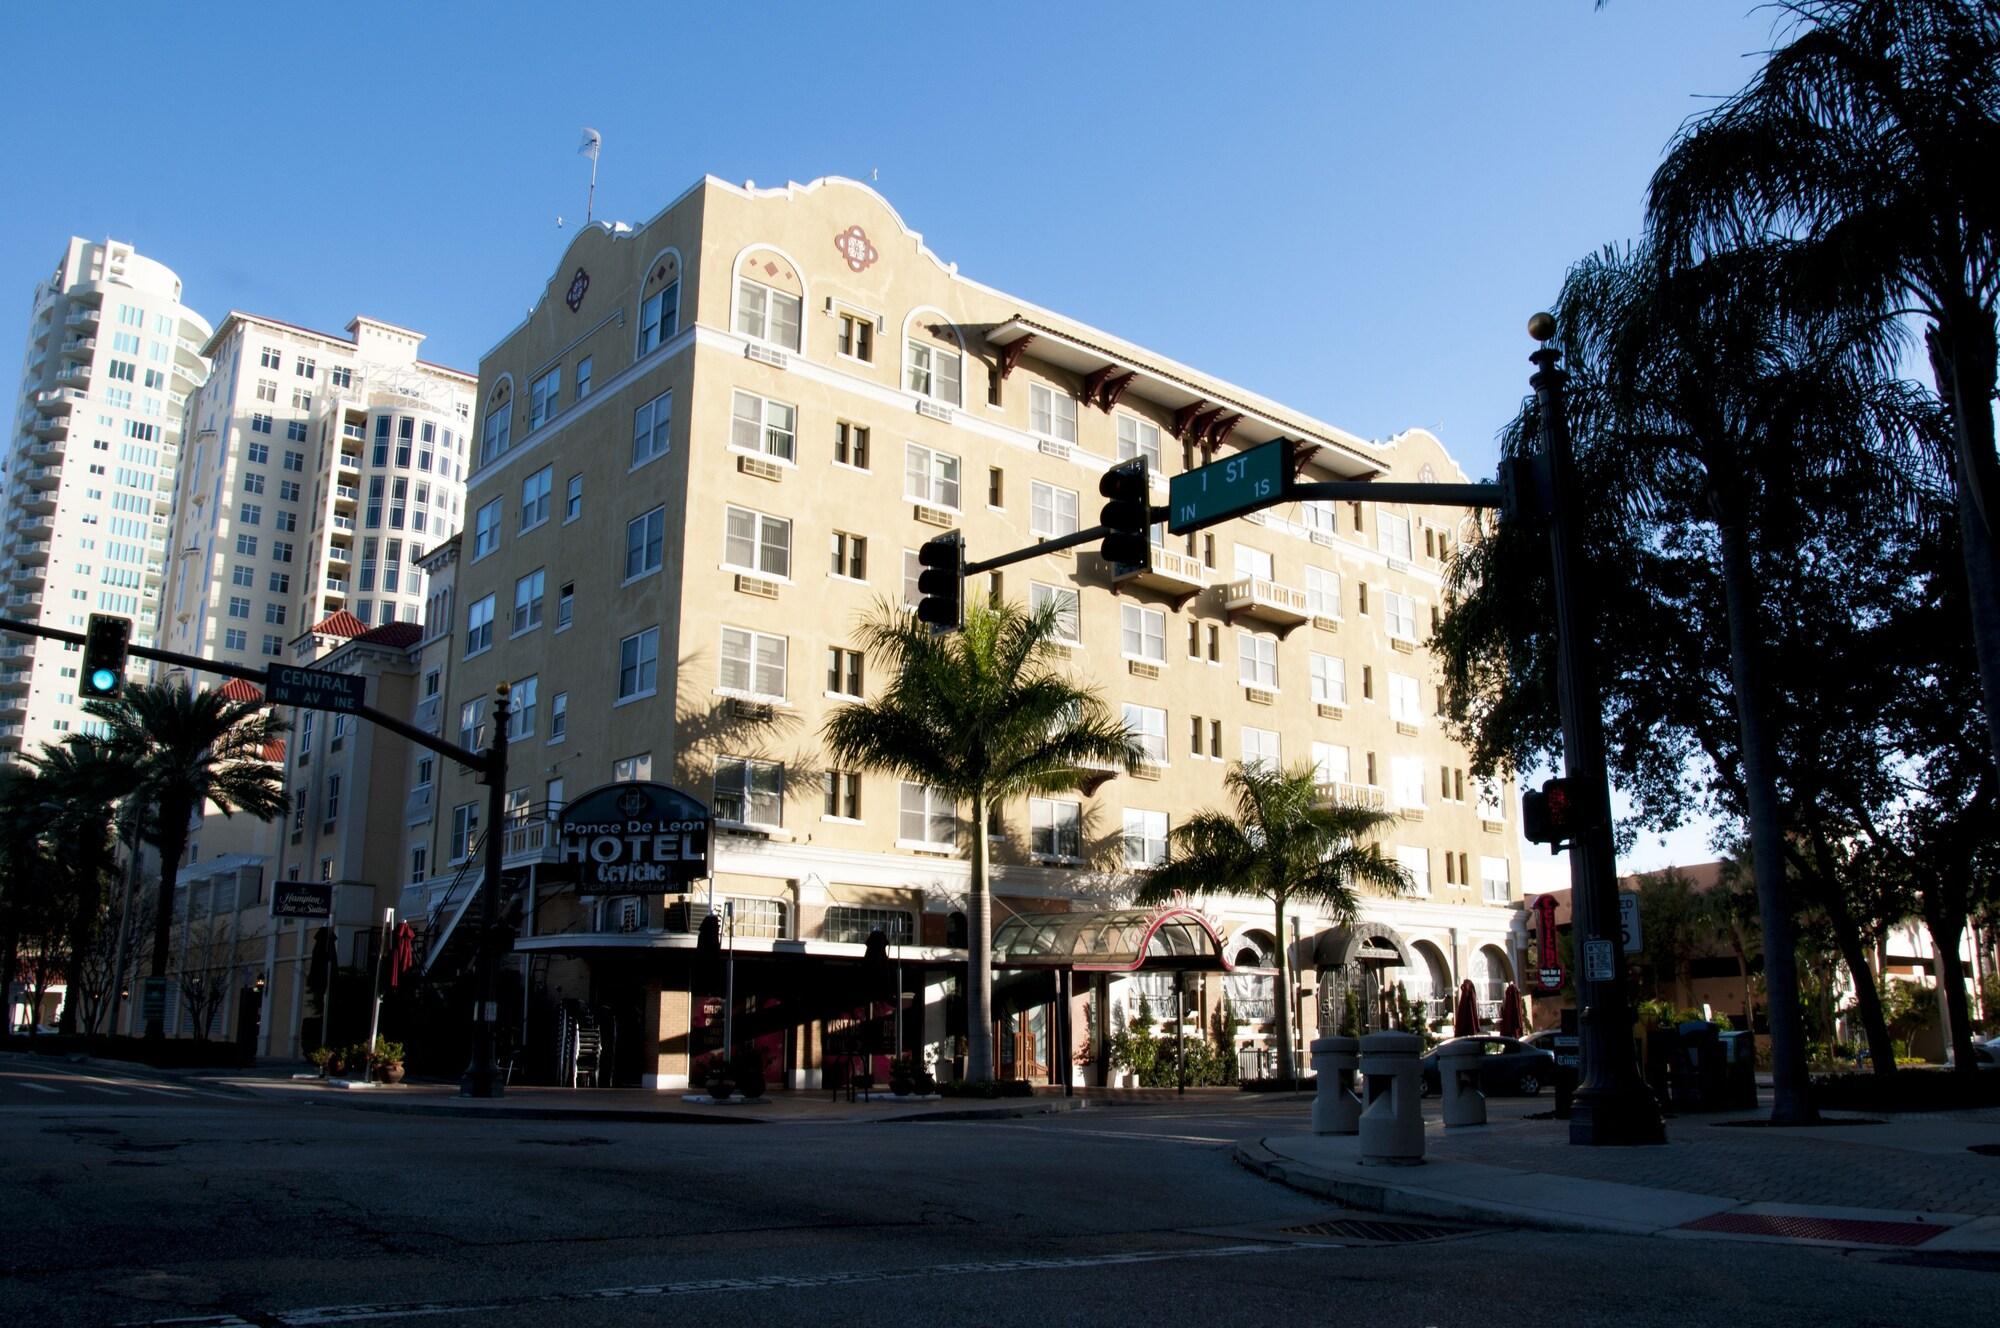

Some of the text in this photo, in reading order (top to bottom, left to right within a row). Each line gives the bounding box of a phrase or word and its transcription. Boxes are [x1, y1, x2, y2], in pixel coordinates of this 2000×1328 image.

[1225, 456, 1248, 483] ST
[281, 669, 352, 693] CENTRAL
[563, 817, 705, 835] Ponce De Leon
[560, 833, 704, 864] HOTEL
[597, 861, 668, 883] Ceviche
[279, 891, 323, 905] Hampton
